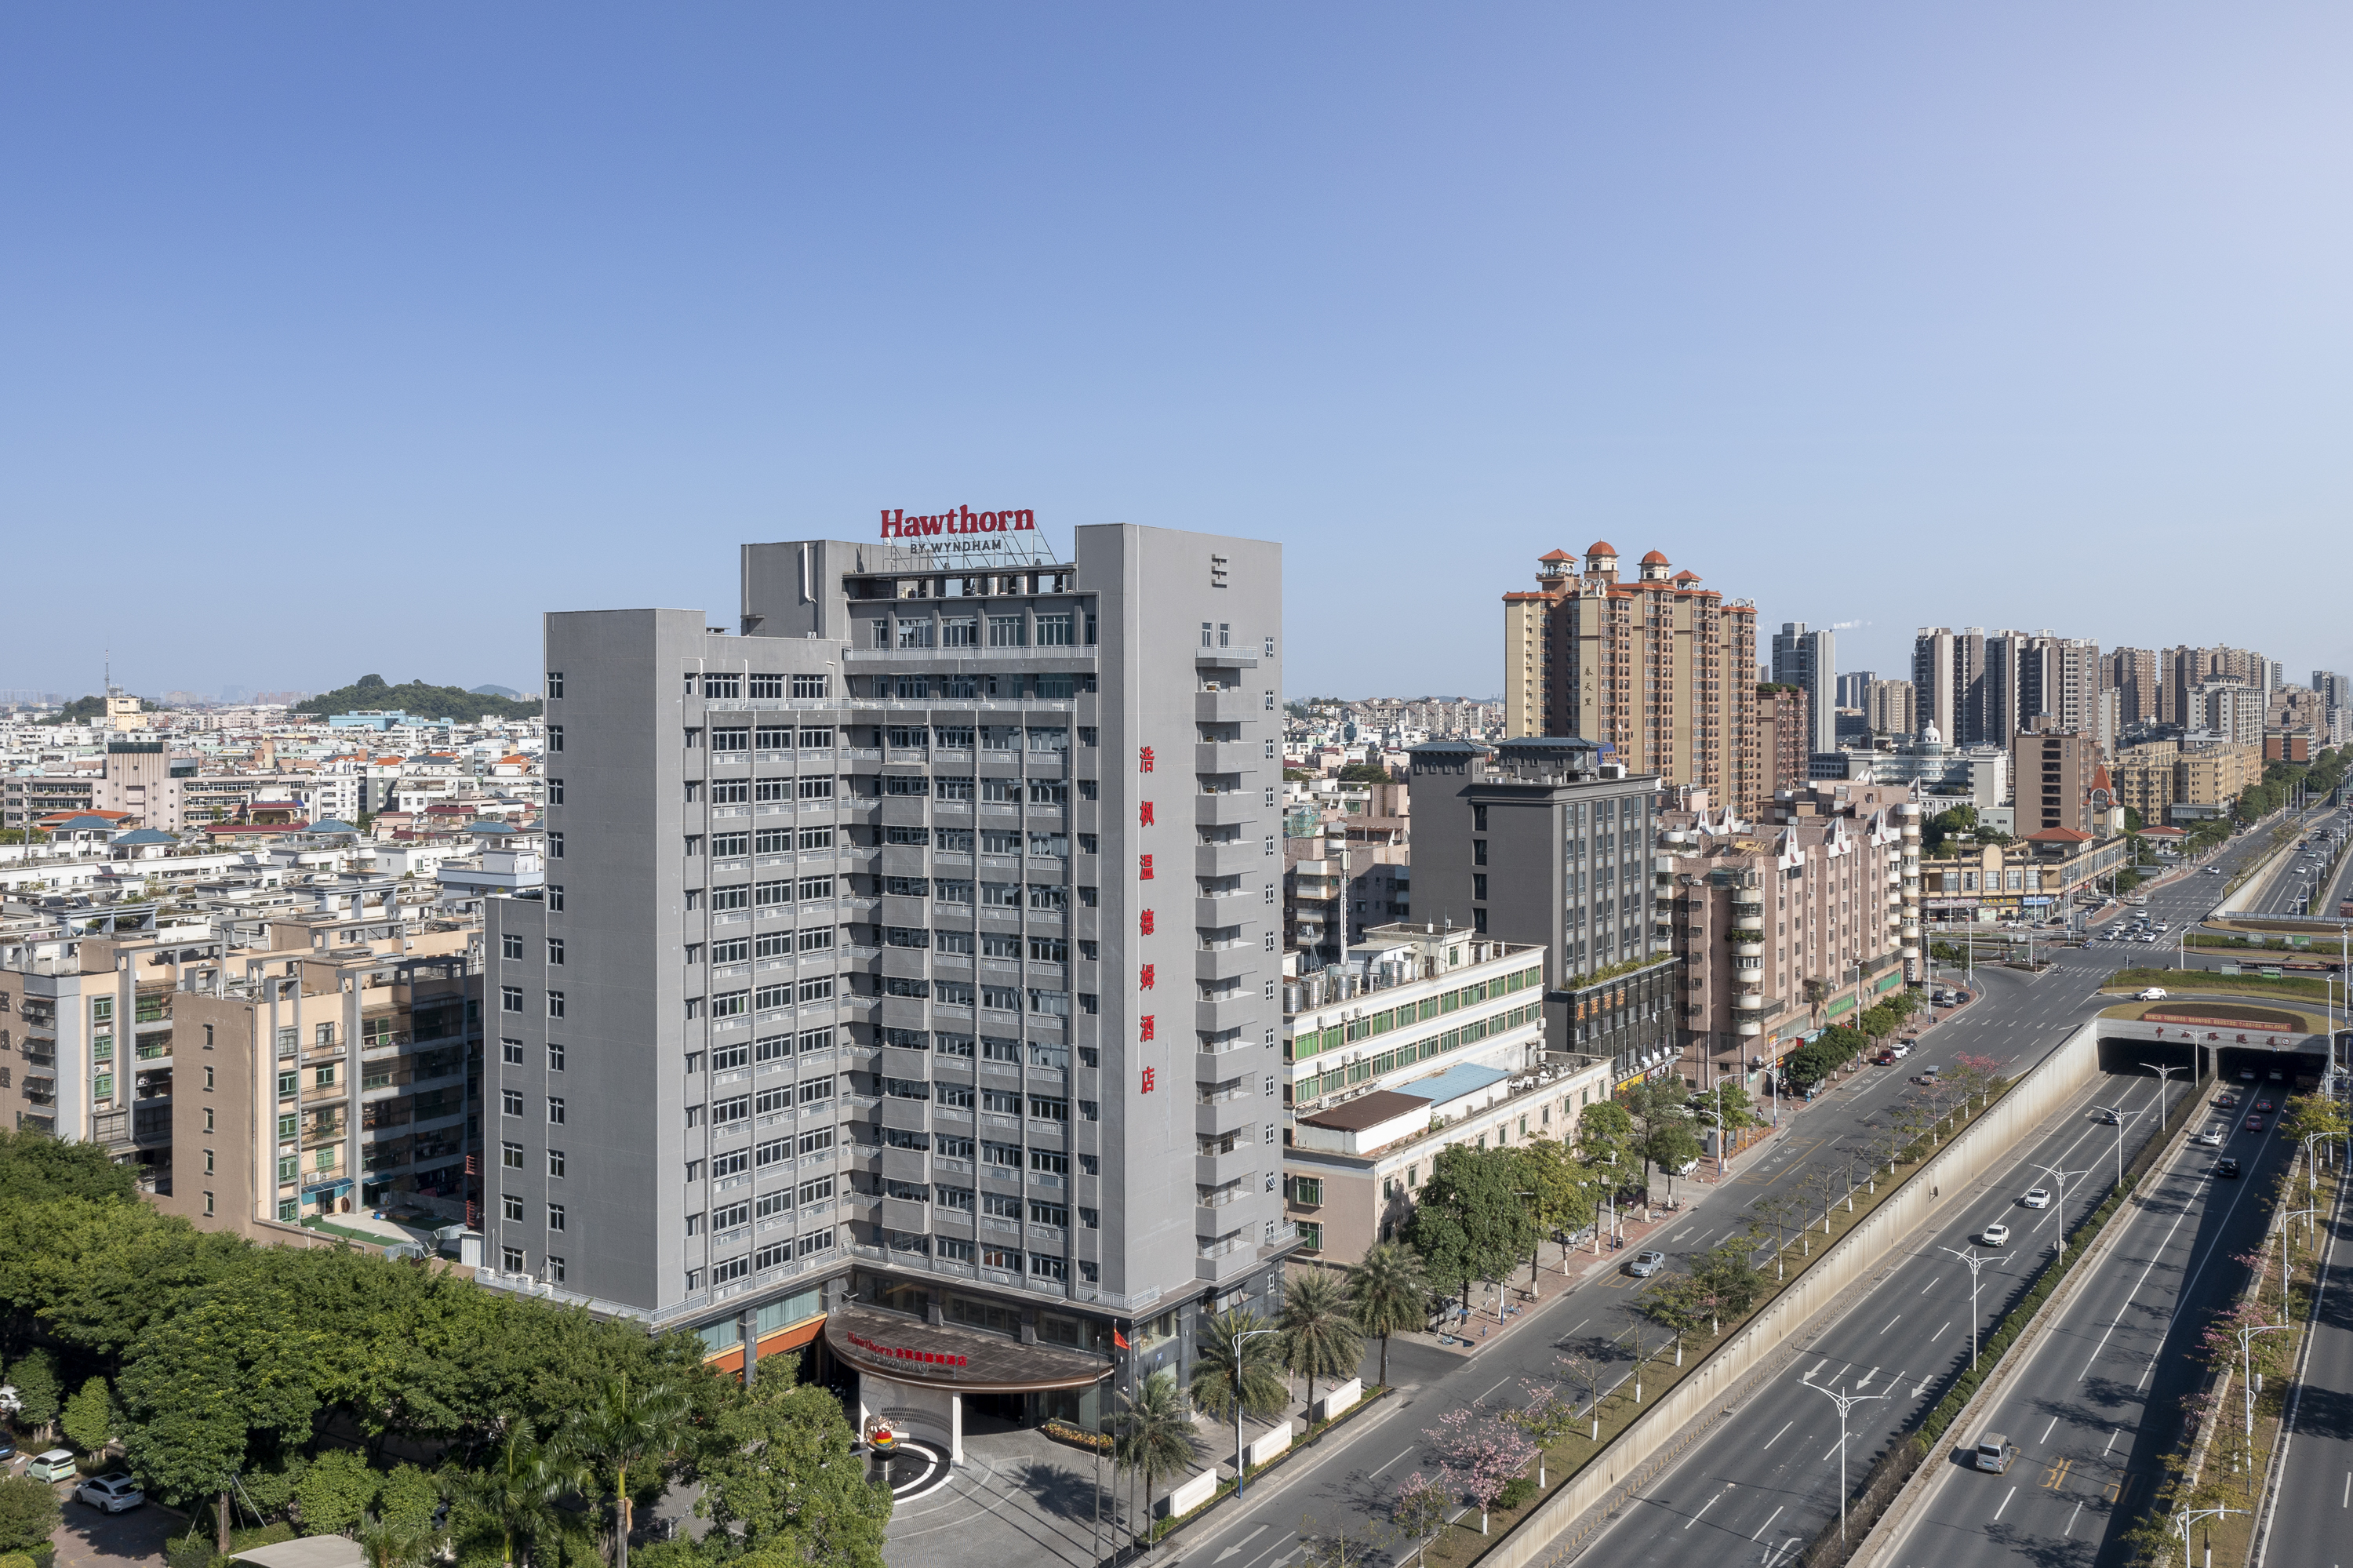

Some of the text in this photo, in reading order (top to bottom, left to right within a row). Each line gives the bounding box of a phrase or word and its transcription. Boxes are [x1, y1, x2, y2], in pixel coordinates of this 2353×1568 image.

[880, 504, 1035, 538] Hawthorn
[911, 539, 1001, 555] BY WYNDHAM
[1140, 746, 1155, 1094] 浩枫温德姆酒店
